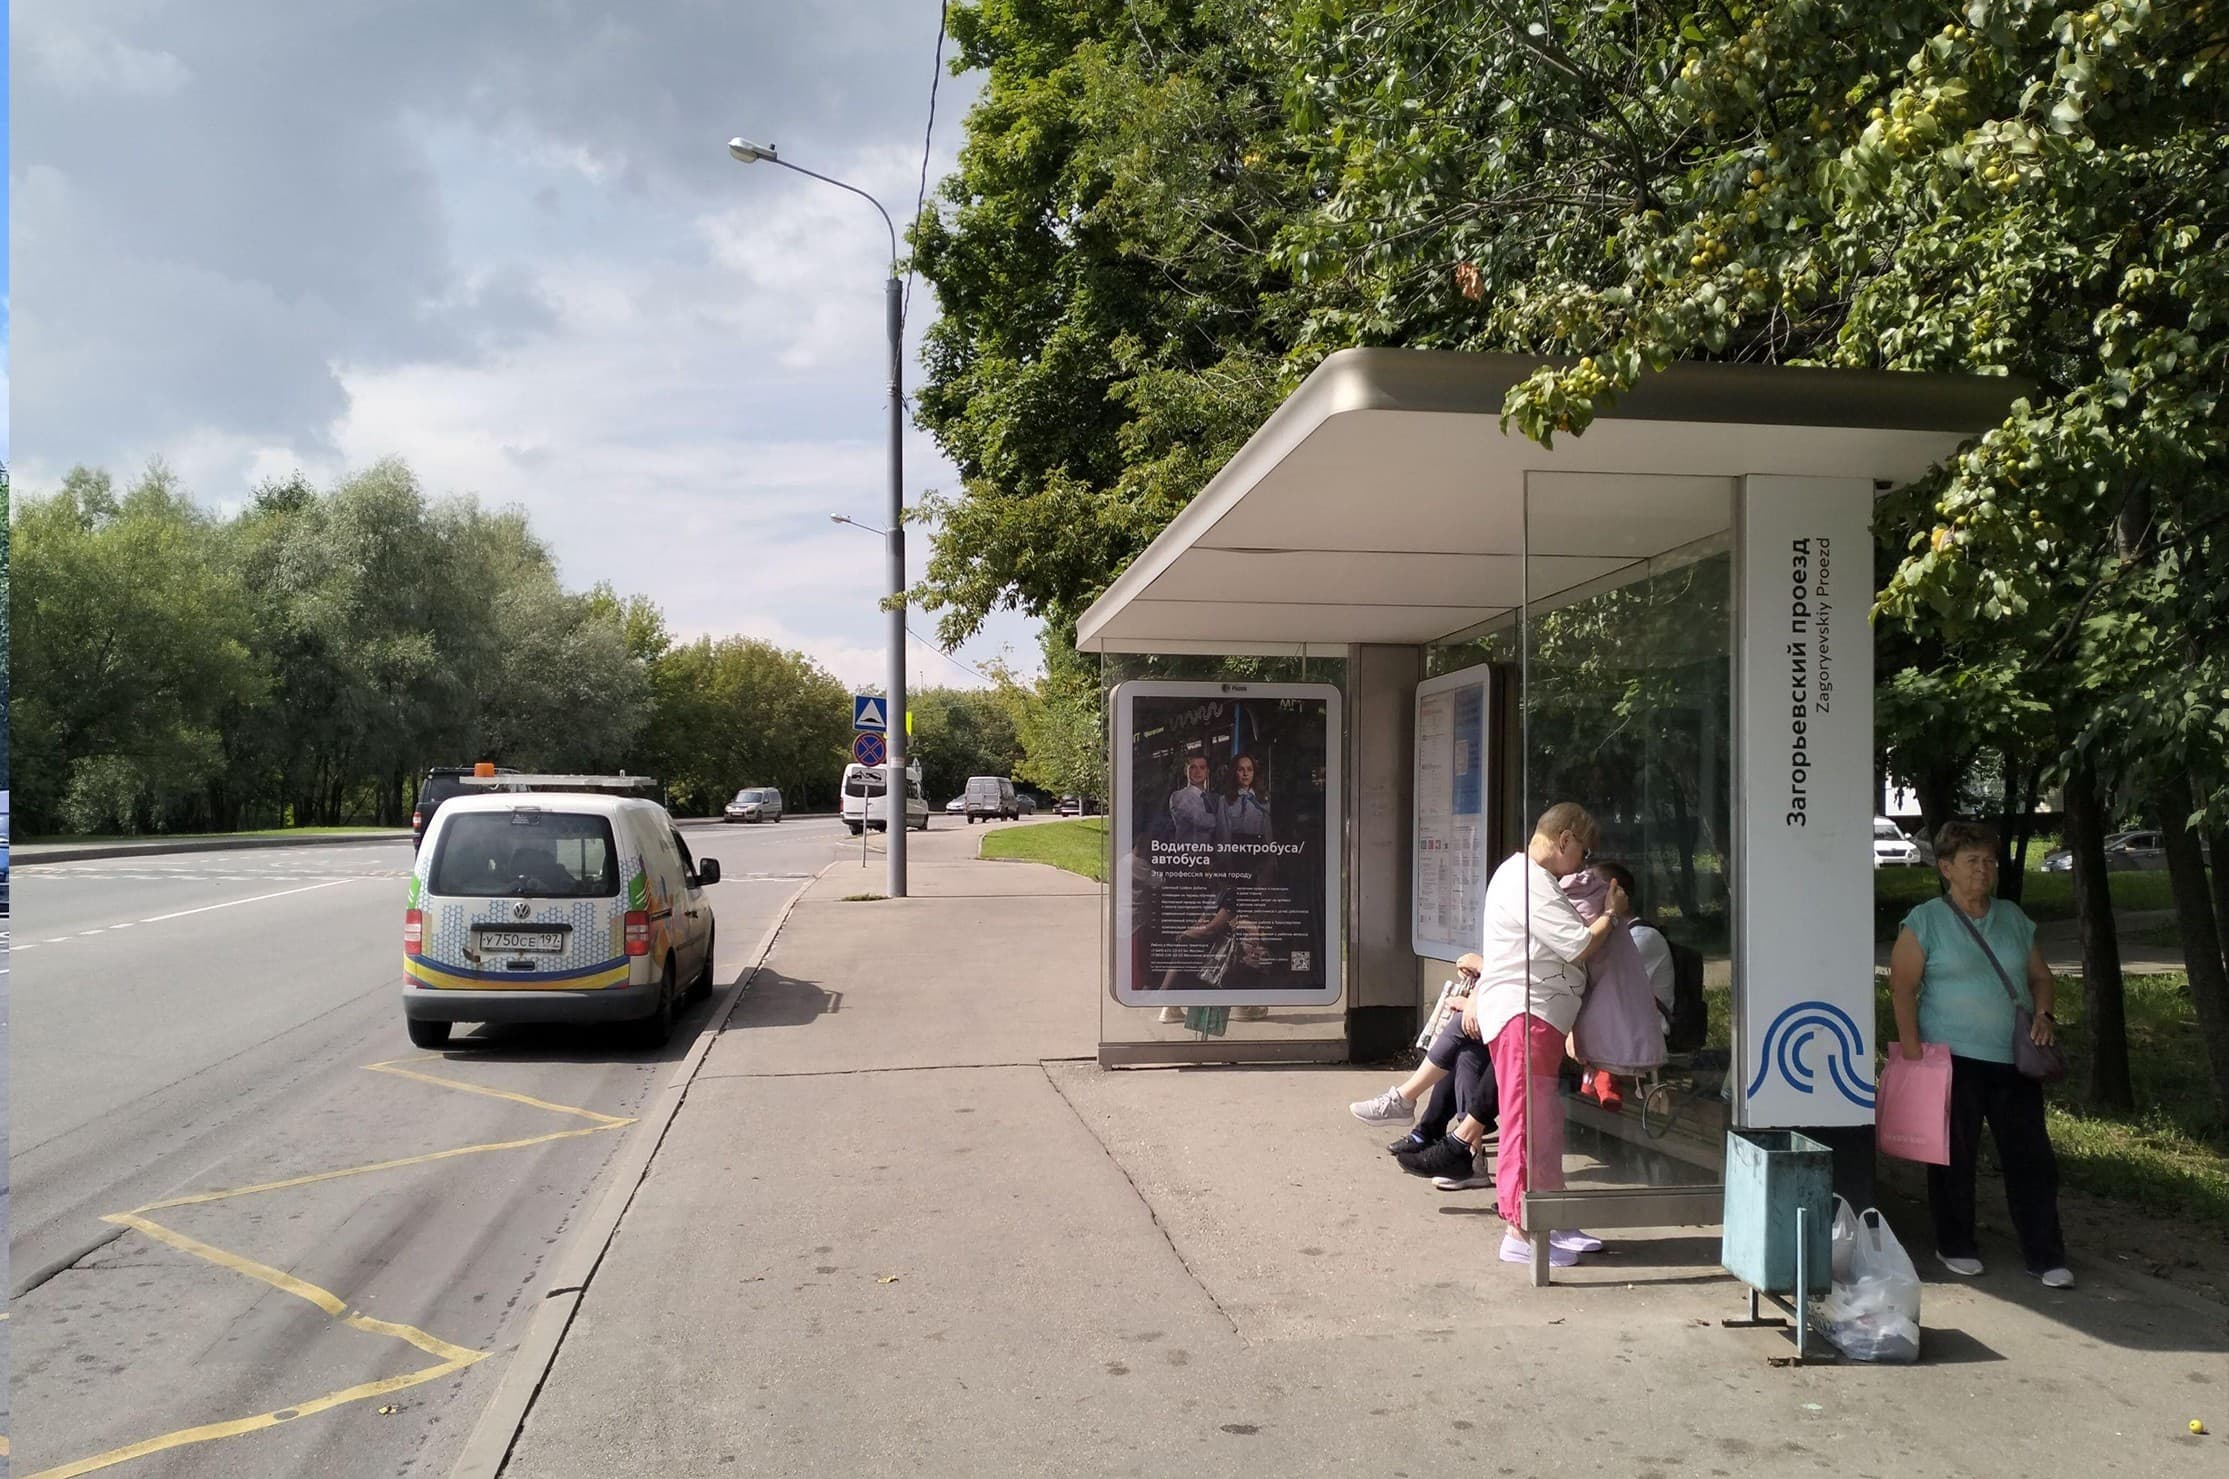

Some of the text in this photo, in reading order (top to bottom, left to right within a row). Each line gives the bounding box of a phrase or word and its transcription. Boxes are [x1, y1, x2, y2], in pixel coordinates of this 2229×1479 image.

[1816, 537, 1832, 713] Zagoryevskiy Proezd
[1787, 538, 1811, 827] Загорьевский проезд
[1151, 840, 1305, 855] Водитель электробуса/
[1151, 853, 1210, 867] автобуса
[1165, 870, 1203, 879] профессия
[540, 934, 558, 945] 197
